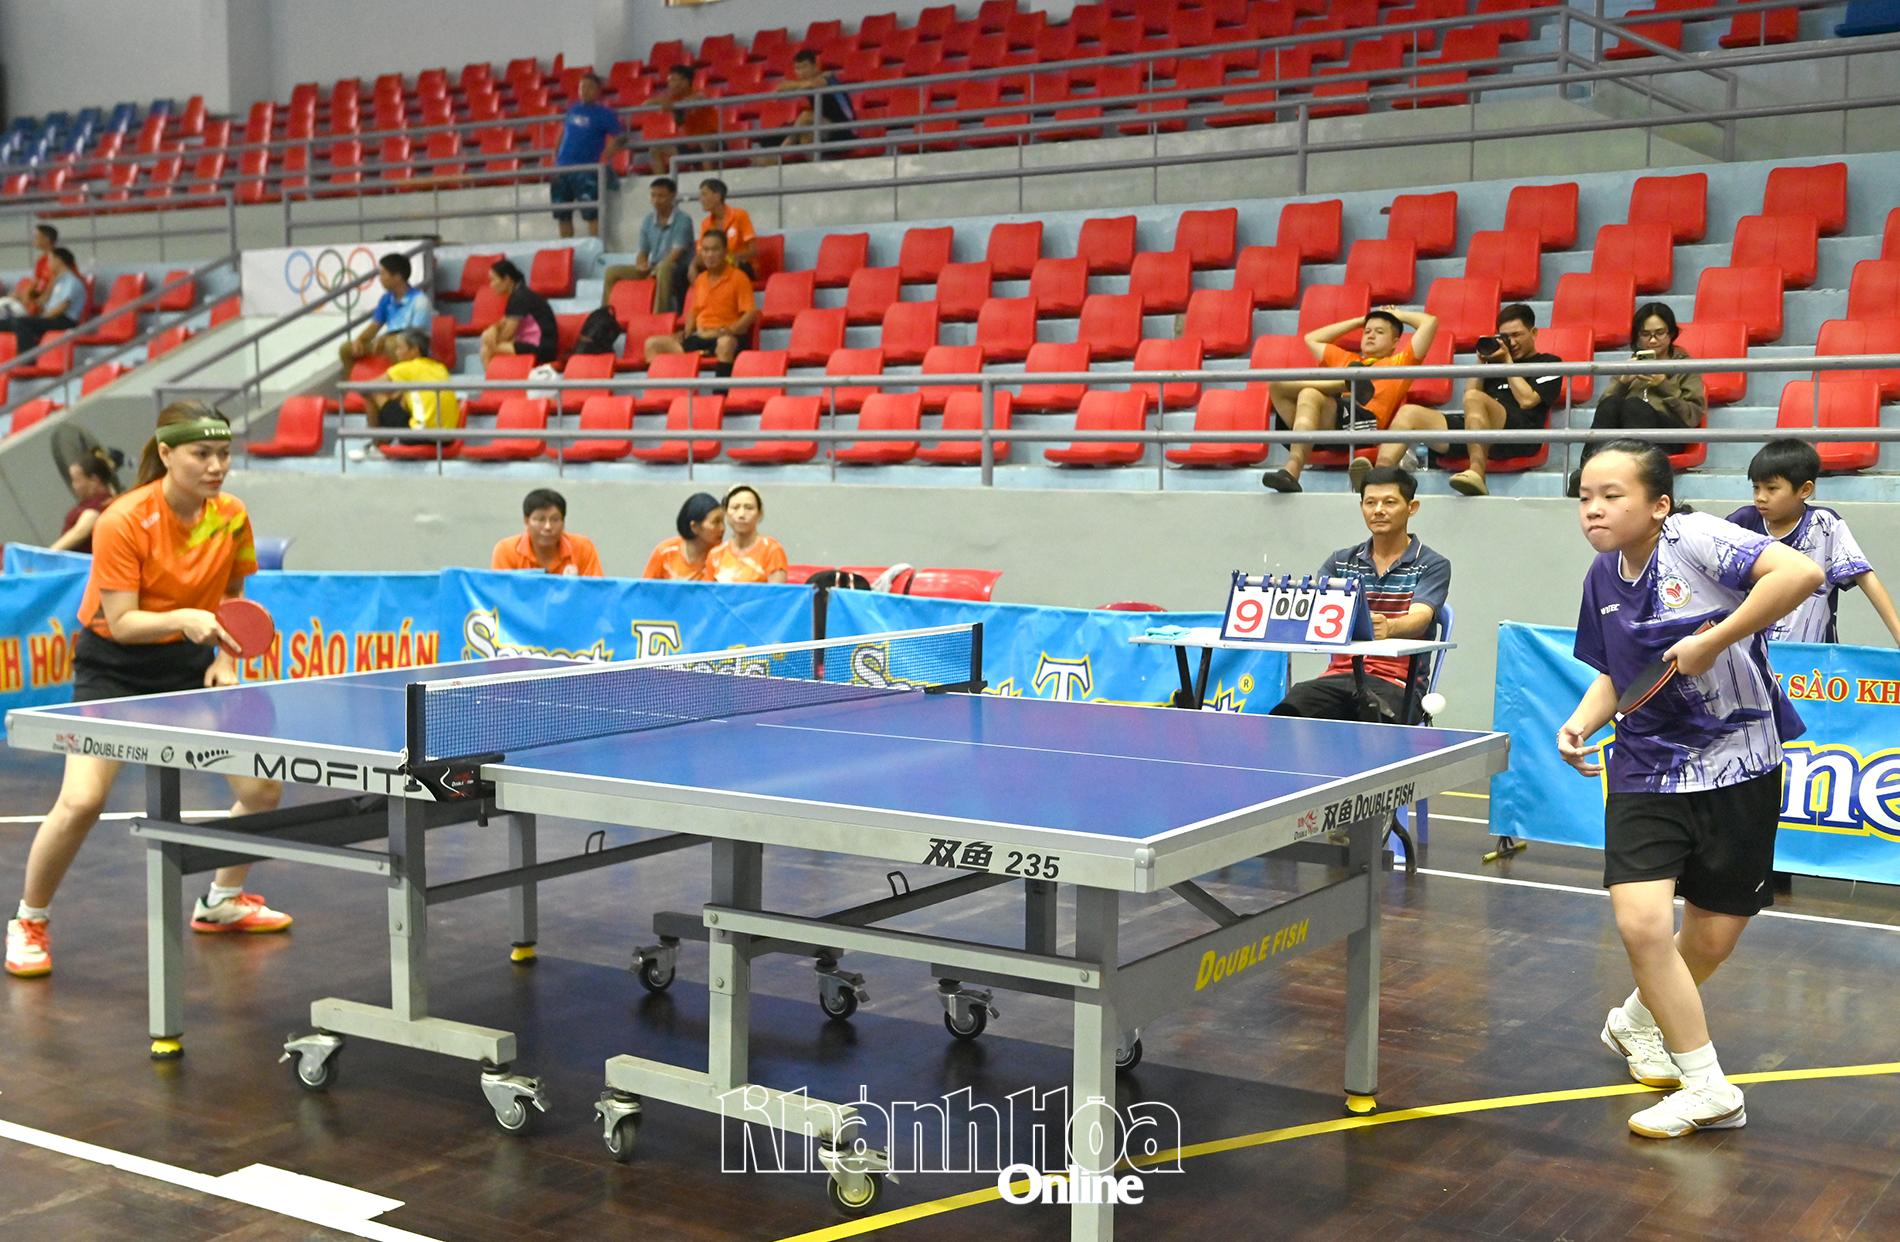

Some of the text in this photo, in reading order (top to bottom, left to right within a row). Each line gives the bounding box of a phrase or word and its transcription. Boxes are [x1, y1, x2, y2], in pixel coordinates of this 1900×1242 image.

[1233, 599, 1264, 634] 9
[1313, 604, 1345, 639] 3
[289, 616, 348, 680] SÀO
[355, 617, 440, 673] KHÁN
[1789, 668, 1849, 702] SÀO
[83, 737, 124, 758] DOUBLE
[126, 747, 149, 762] FISH
[1353, 788, 1393, 821] DOUBLE
[1393, 781, 1415, 807] FISH
[922, 837, 1060, 879] 双鱼 235
[1195, 918, 1310, 991] DOUBLE FISH
